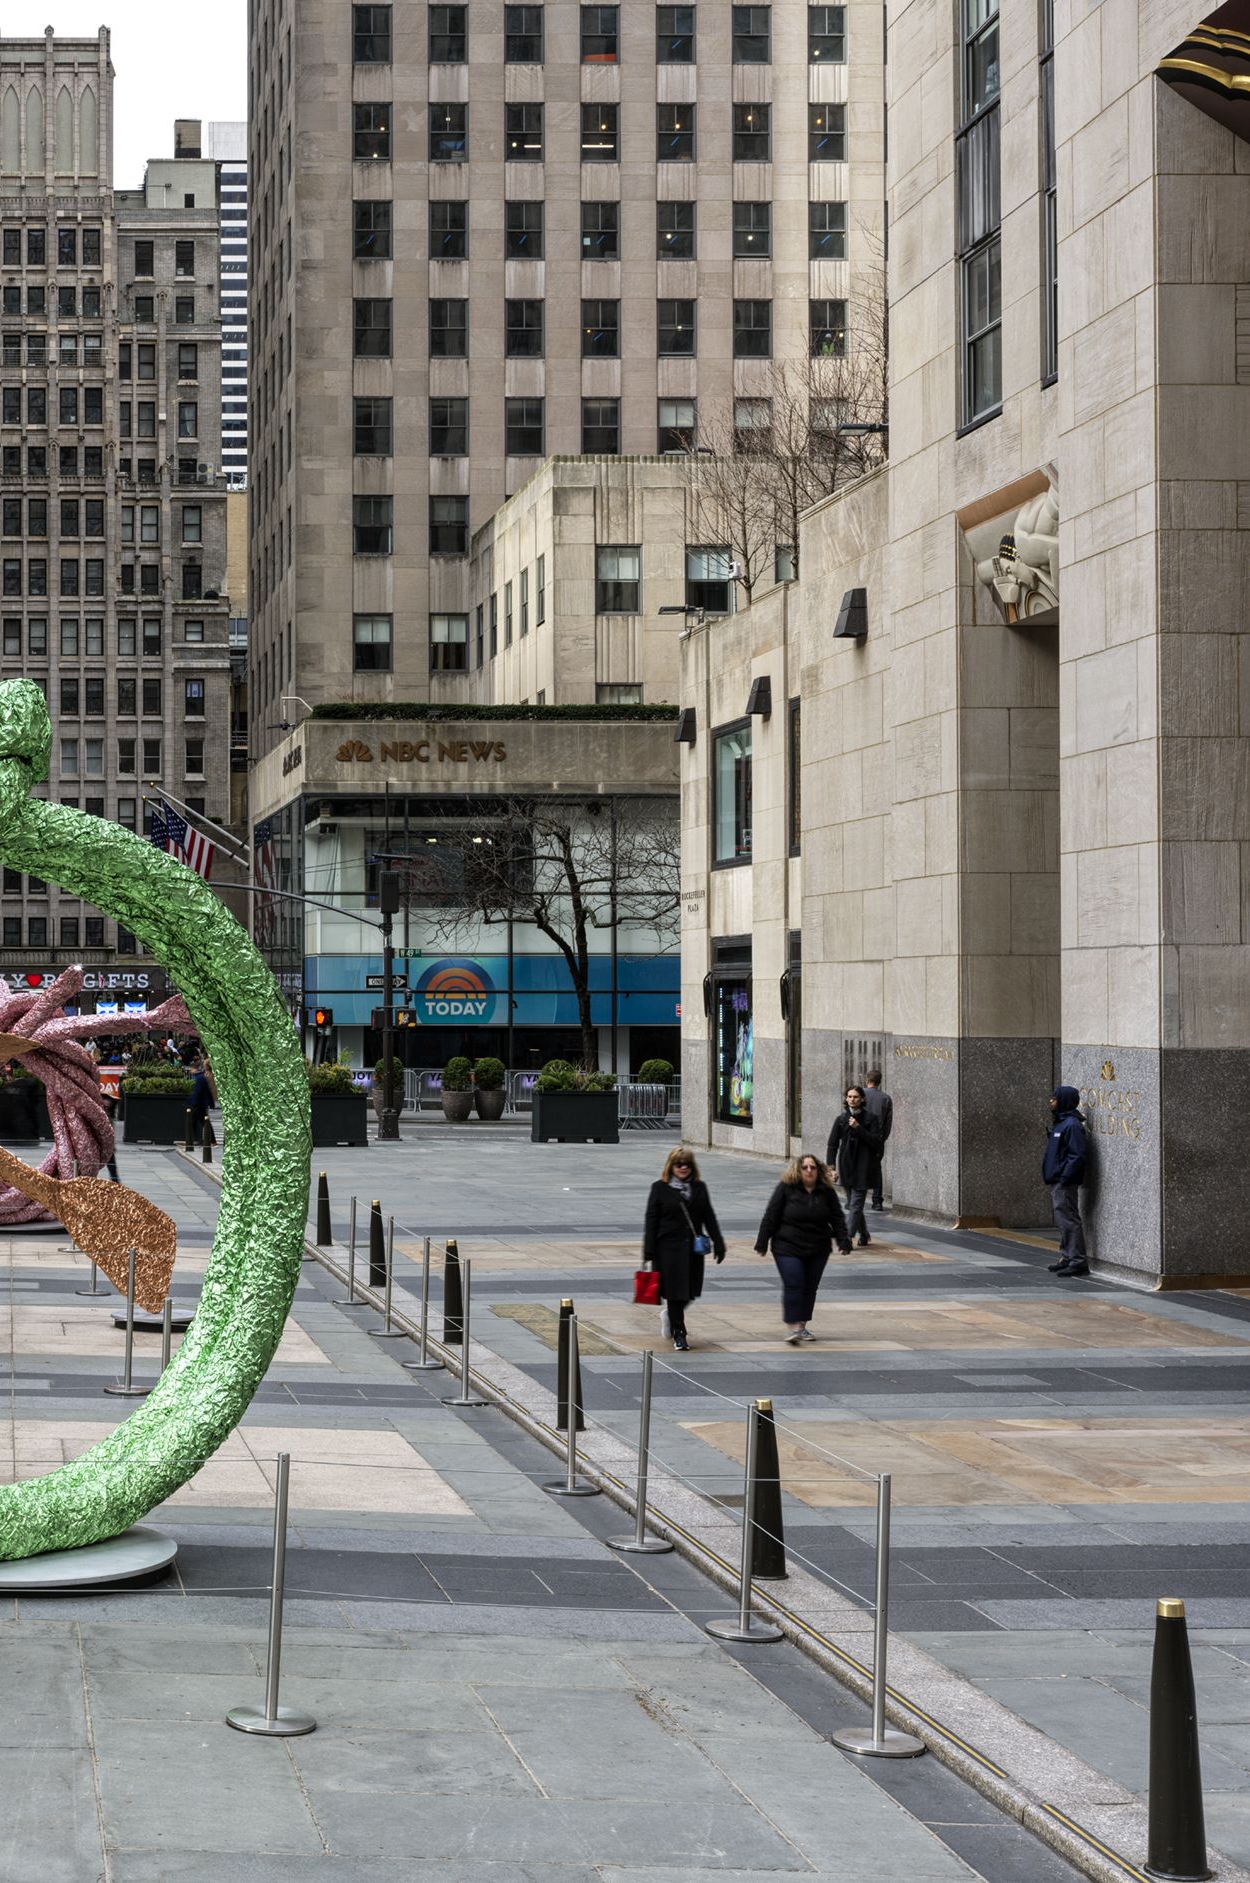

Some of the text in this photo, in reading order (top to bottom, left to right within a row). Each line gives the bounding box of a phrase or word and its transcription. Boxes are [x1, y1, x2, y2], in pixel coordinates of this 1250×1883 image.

[380, 740, 507, 763] NBC NEWS
[425, 1002, 486, 1015] TODAY
[1080, 1087, 1139, 1111] COMCAST
[1082, 1113, 1140, 1140] UILDING
